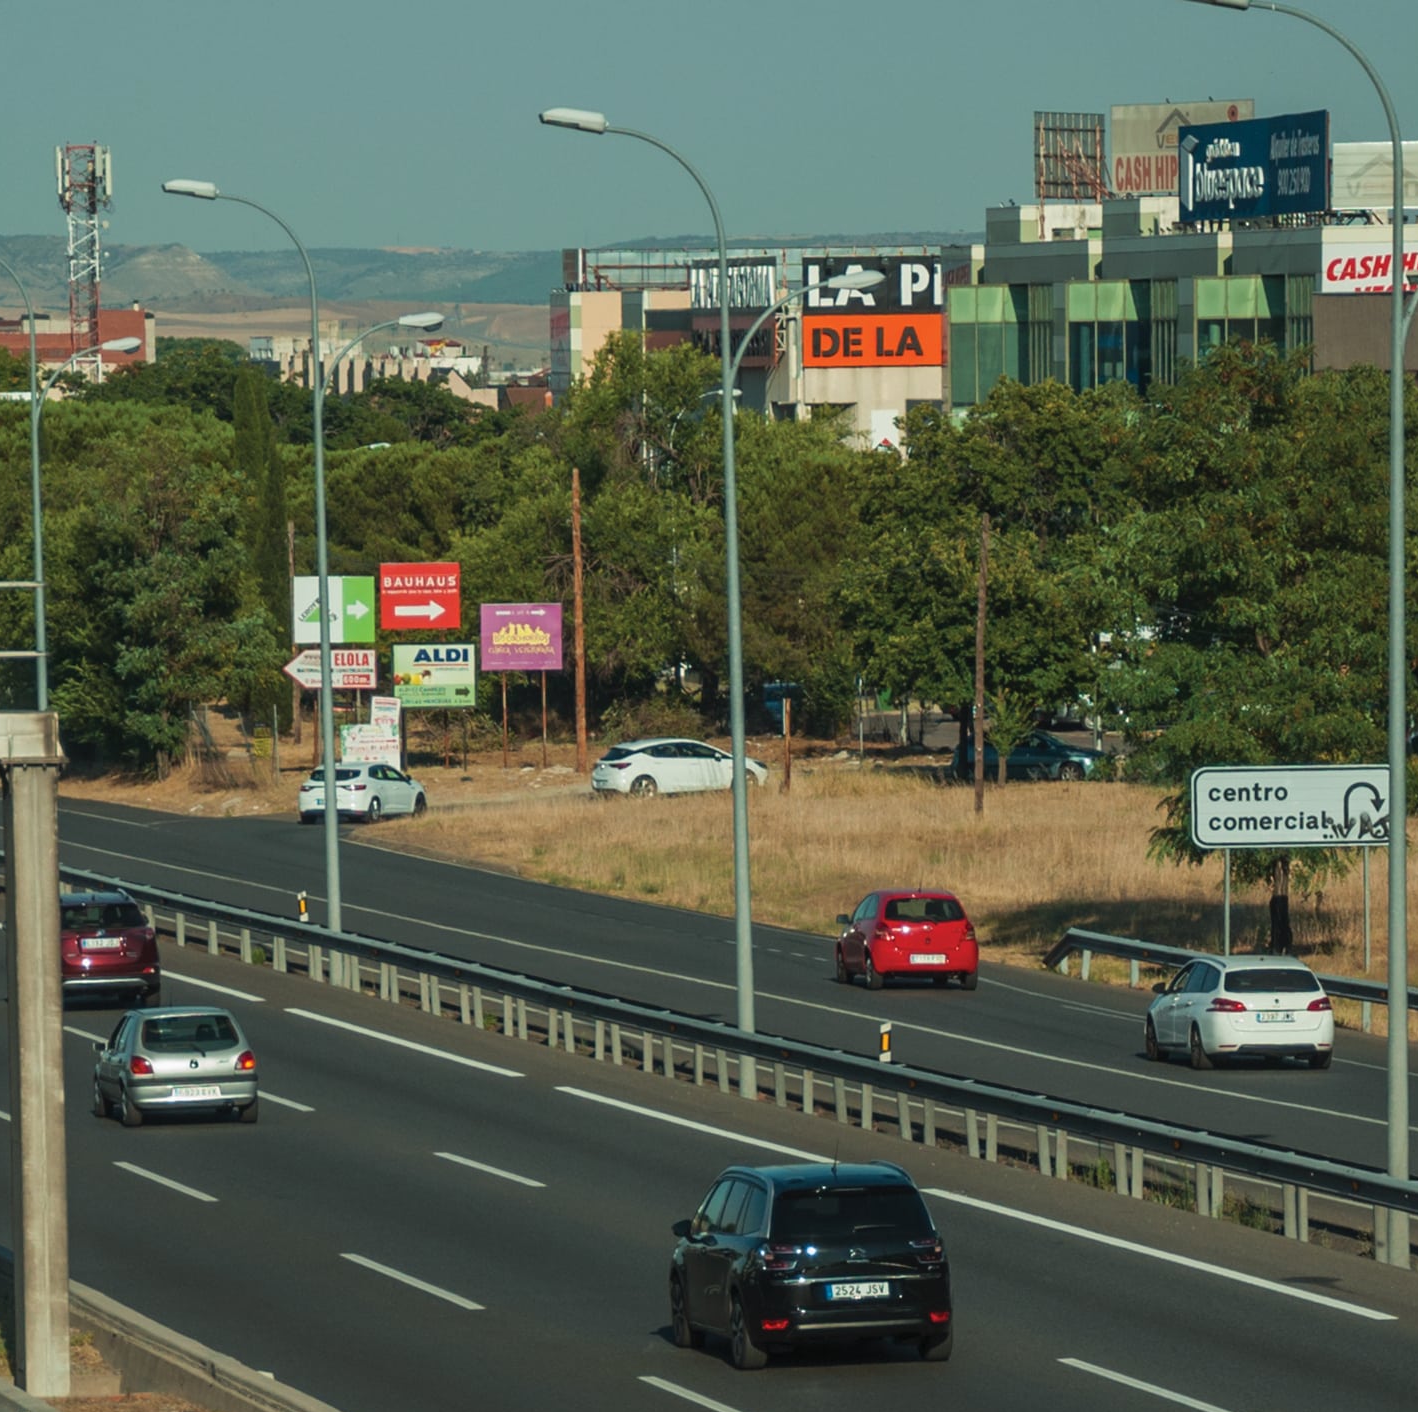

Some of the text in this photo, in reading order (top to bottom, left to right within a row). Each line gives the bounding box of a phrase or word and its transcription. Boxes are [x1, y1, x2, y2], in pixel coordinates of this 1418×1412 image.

[1115, 154, 1151, 191] CASH
[1326, 254, 1391, 282] CASH
[812, 326, 923, 358] DE LA
[383, 575, 458, 588] BAUHAUS
[334, 652, 370, 667] ELOLA
[413, 648, 469, 662] ALDI
[1208, 782, 1288, 802] centro
[1208, 811, 1328, 831] comercial
[835, 1284, 861, 1296] 2524
